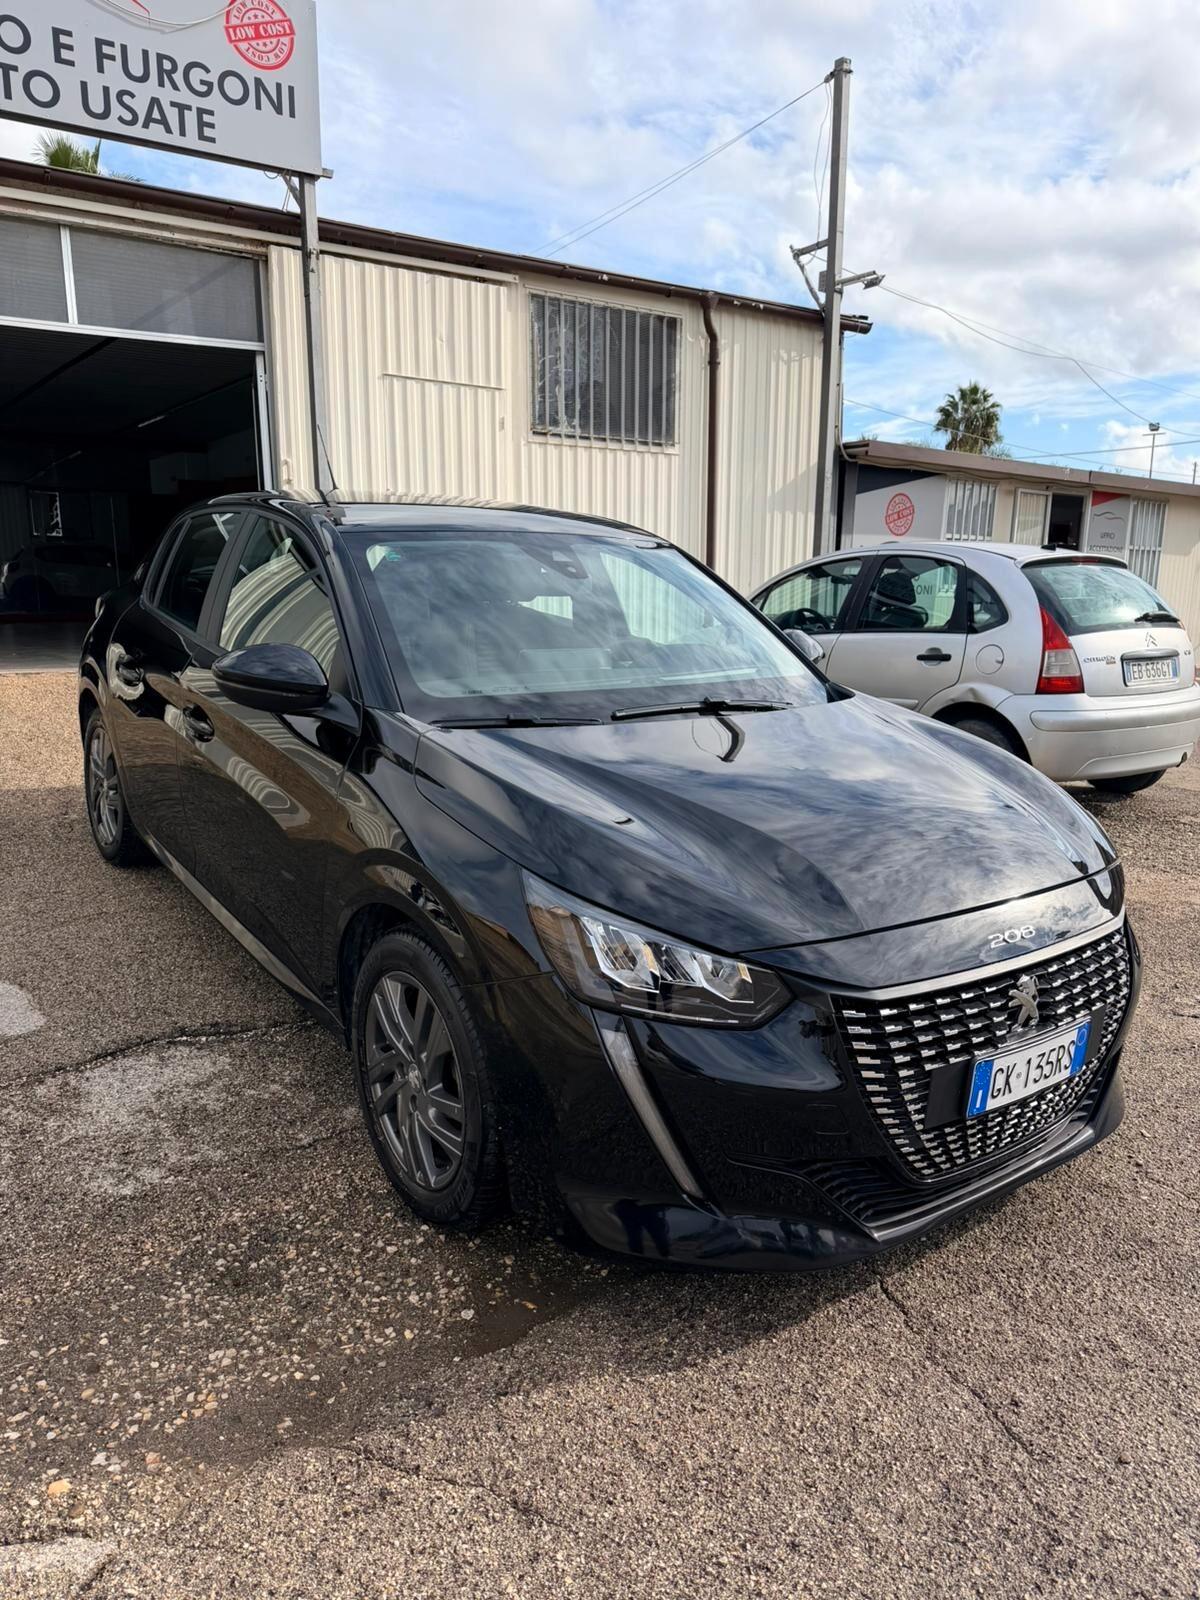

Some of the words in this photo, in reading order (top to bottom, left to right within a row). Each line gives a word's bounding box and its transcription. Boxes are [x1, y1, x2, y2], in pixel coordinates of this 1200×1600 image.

[228, 25, 256, 41] LOW
[259, 21, 291, 37] COST
[51, 26, 75, 67] E
[95, 37, 296, 118] FURGONI
[80, 81, 216, 143] USATE
[988, 925, 1036, 949] 208
